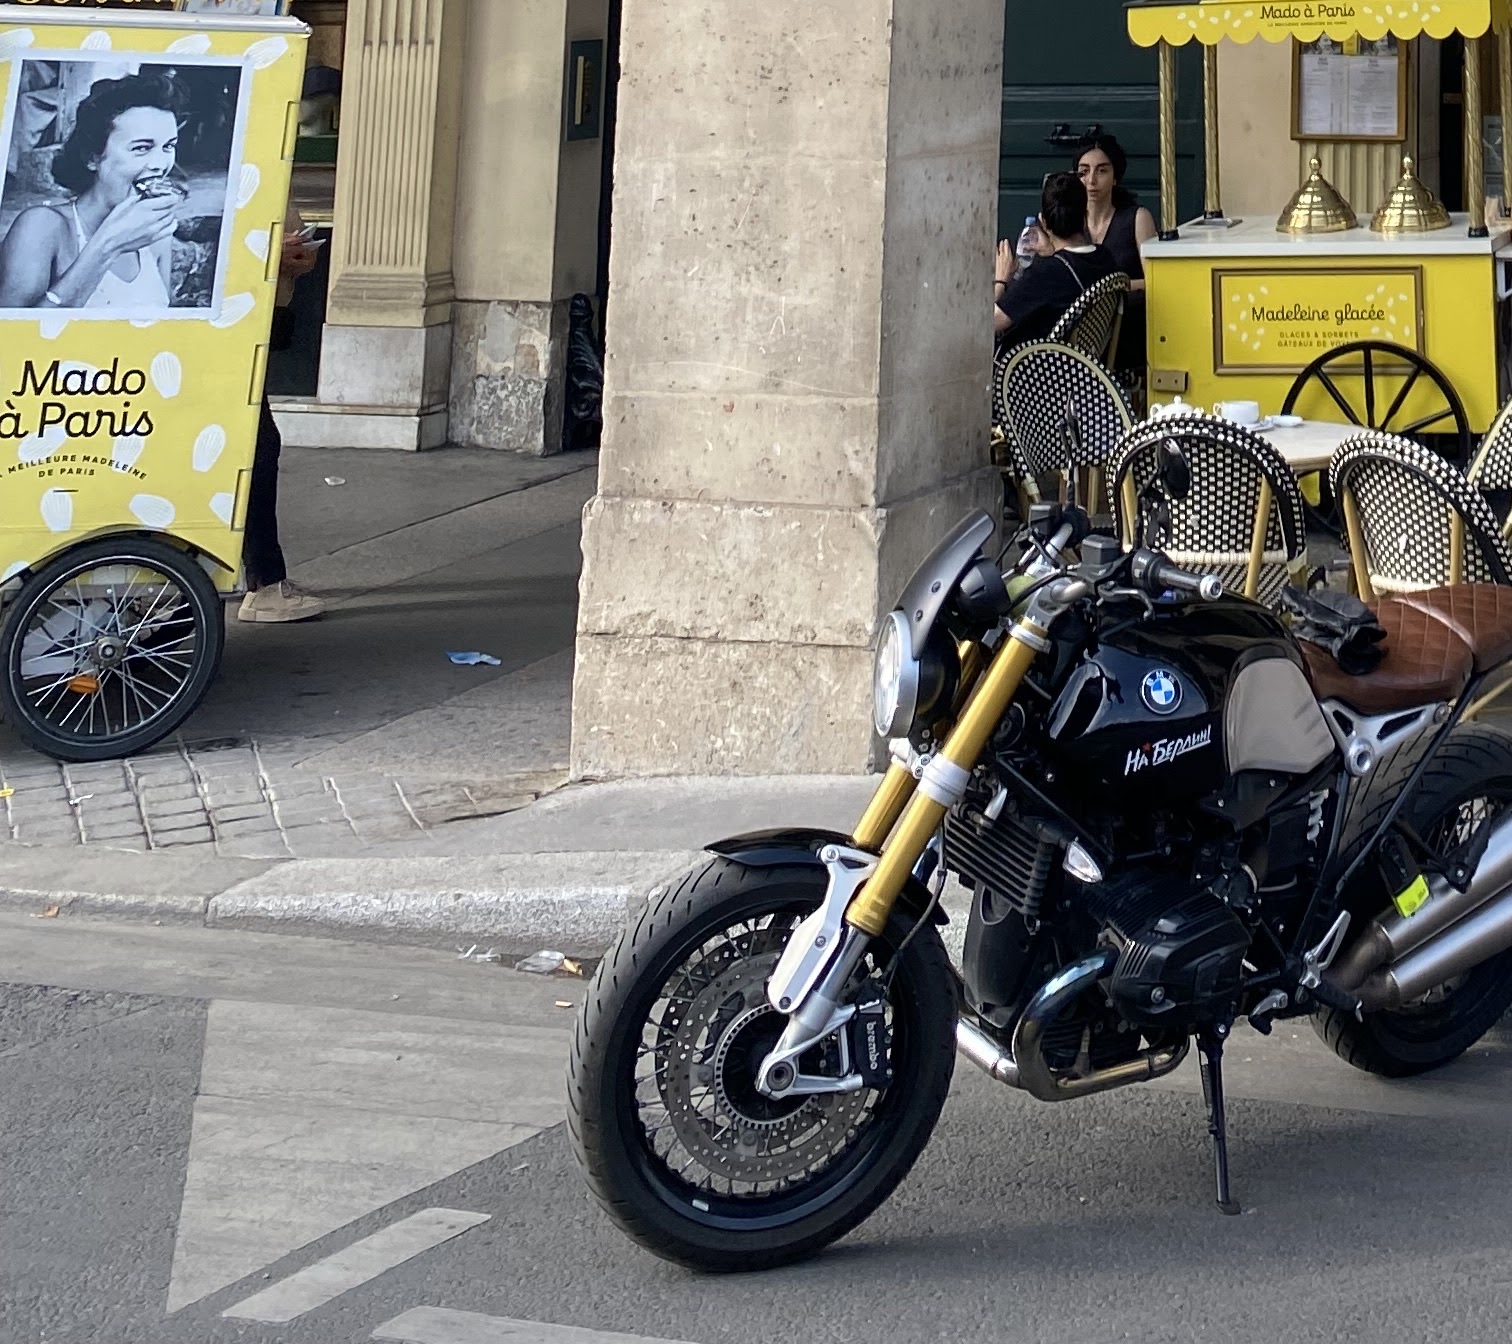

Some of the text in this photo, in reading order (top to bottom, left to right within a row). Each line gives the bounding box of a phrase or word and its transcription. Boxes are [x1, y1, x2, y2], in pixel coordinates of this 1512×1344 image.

[1260, 2, 1355, 19] Mado à Paris
[1252, 303, 1386, 326] Madeleine glacée
[12, 357, 146, 396] Mado
[0, 399, 154, 438] à Paris
[8, 454, 148, 481] MEILLEURE MADELEINE
[38, 467, 95, 478] DE PARIS
[866, 1021, 879, 1070] brembo
